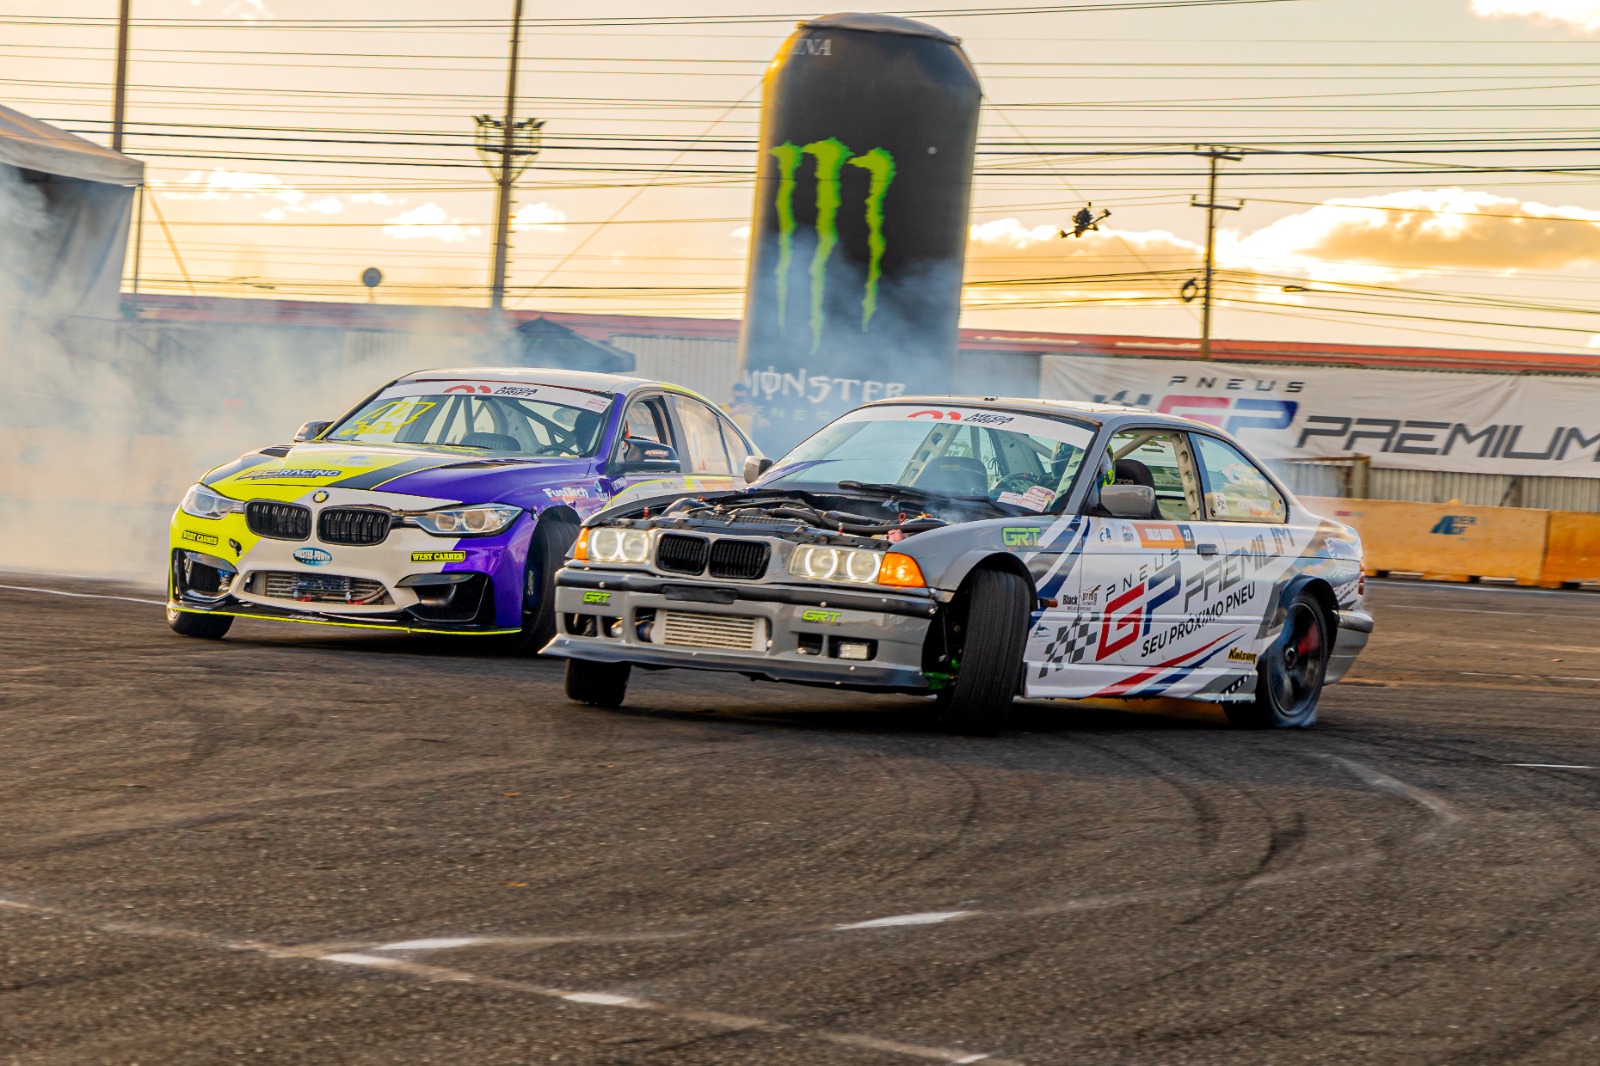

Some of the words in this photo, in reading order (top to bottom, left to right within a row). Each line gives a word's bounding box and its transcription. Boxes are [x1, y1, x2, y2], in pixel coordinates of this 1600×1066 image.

[1167, 375, 1306, 393] PNEUS
[1296, 415, 1600, 462] PREMIUM
[541, 486, 590, 499] FuelTech
[1001, 526, 1042, 547] GRT
[412, 553, 433, 561] WEST
[433, 553, 464, 561] CARNES
[1105, 548, 1179, 602] PNEUS
[1184, 527, 1295, 613] PREMIUM
[583, 591, 611, 603] GRT
[1062, 594, 1079, 606] Black
[802, 609, 842, 623] GRT
[1095, 560, 1182, 661] GP
[1140, 630, 1168, 658] SEU
[1168, 600, 1224, 645] PRÓXIMO
[1225, 581, 1256, 613] PNEU
